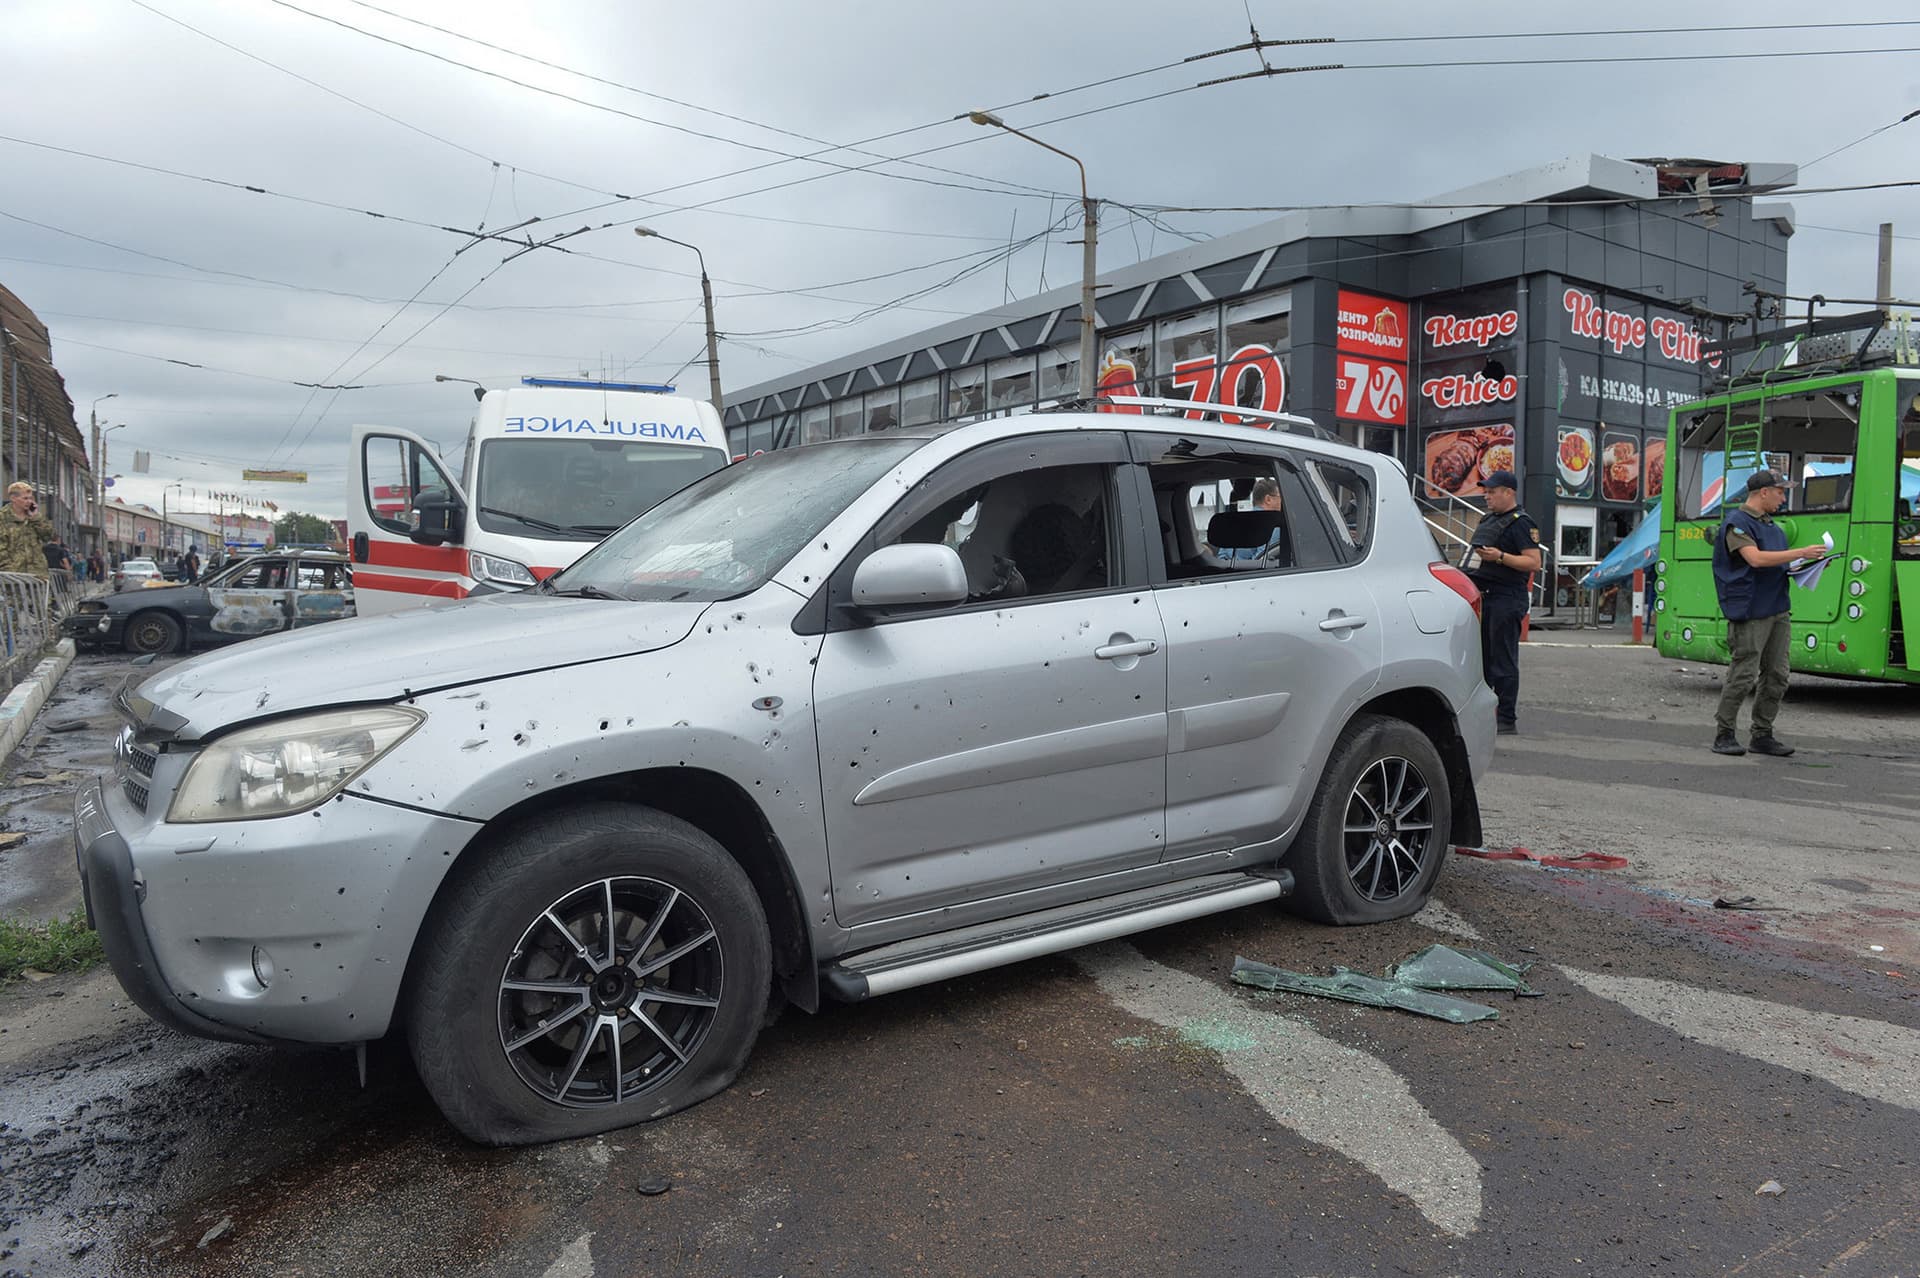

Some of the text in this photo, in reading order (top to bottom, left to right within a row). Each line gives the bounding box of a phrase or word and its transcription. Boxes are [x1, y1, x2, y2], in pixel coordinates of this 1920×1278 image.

[1424, 310, 1518, 347] Кафе
[1563, 288, 1647, 354] Кафе
[1421, 371, 1518, 408] Chico
